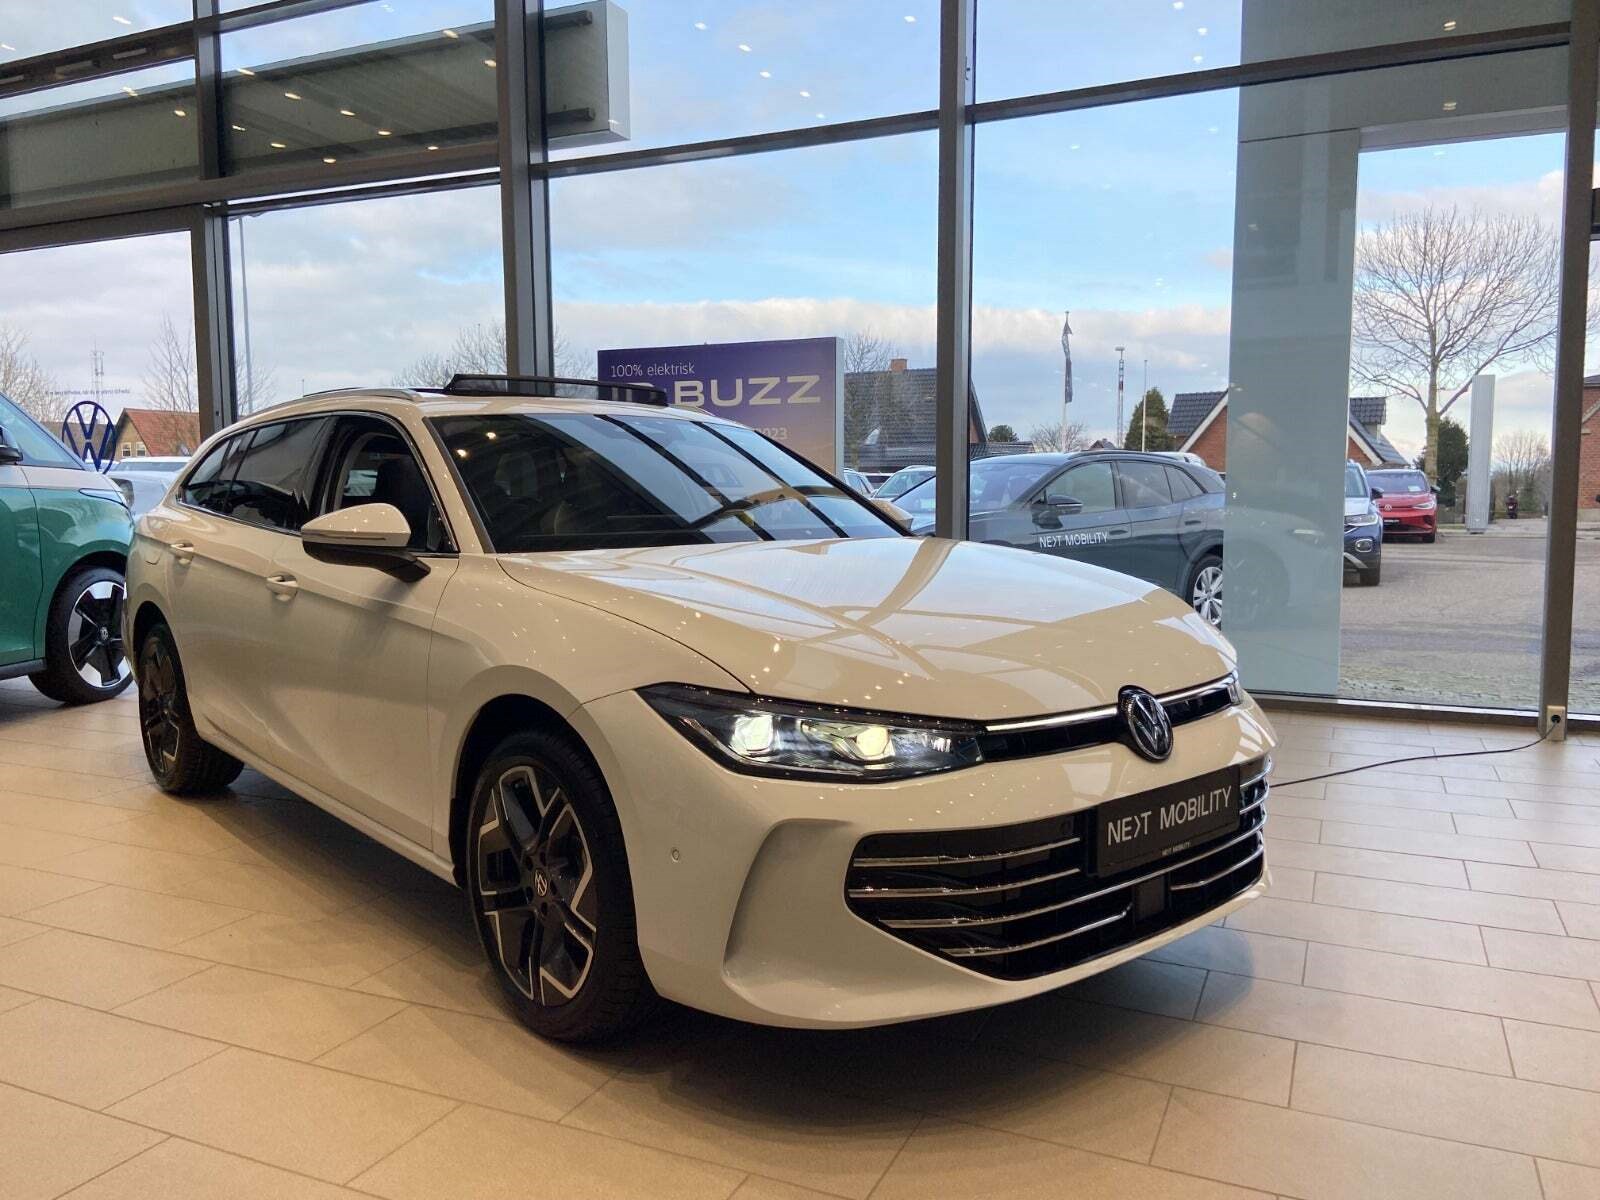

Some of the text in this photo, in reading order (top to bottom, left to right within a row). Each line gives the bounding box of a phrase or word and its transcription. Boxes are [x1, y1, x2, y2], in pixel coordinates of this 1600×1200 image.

[611, 362, 696, 378] 100% elektrisk
[674, 375, 821, 407] BUZZ
[1065, 531, 1108, 546] MOBILITY
[1160, 785, 1232, 830] MOBILITY
